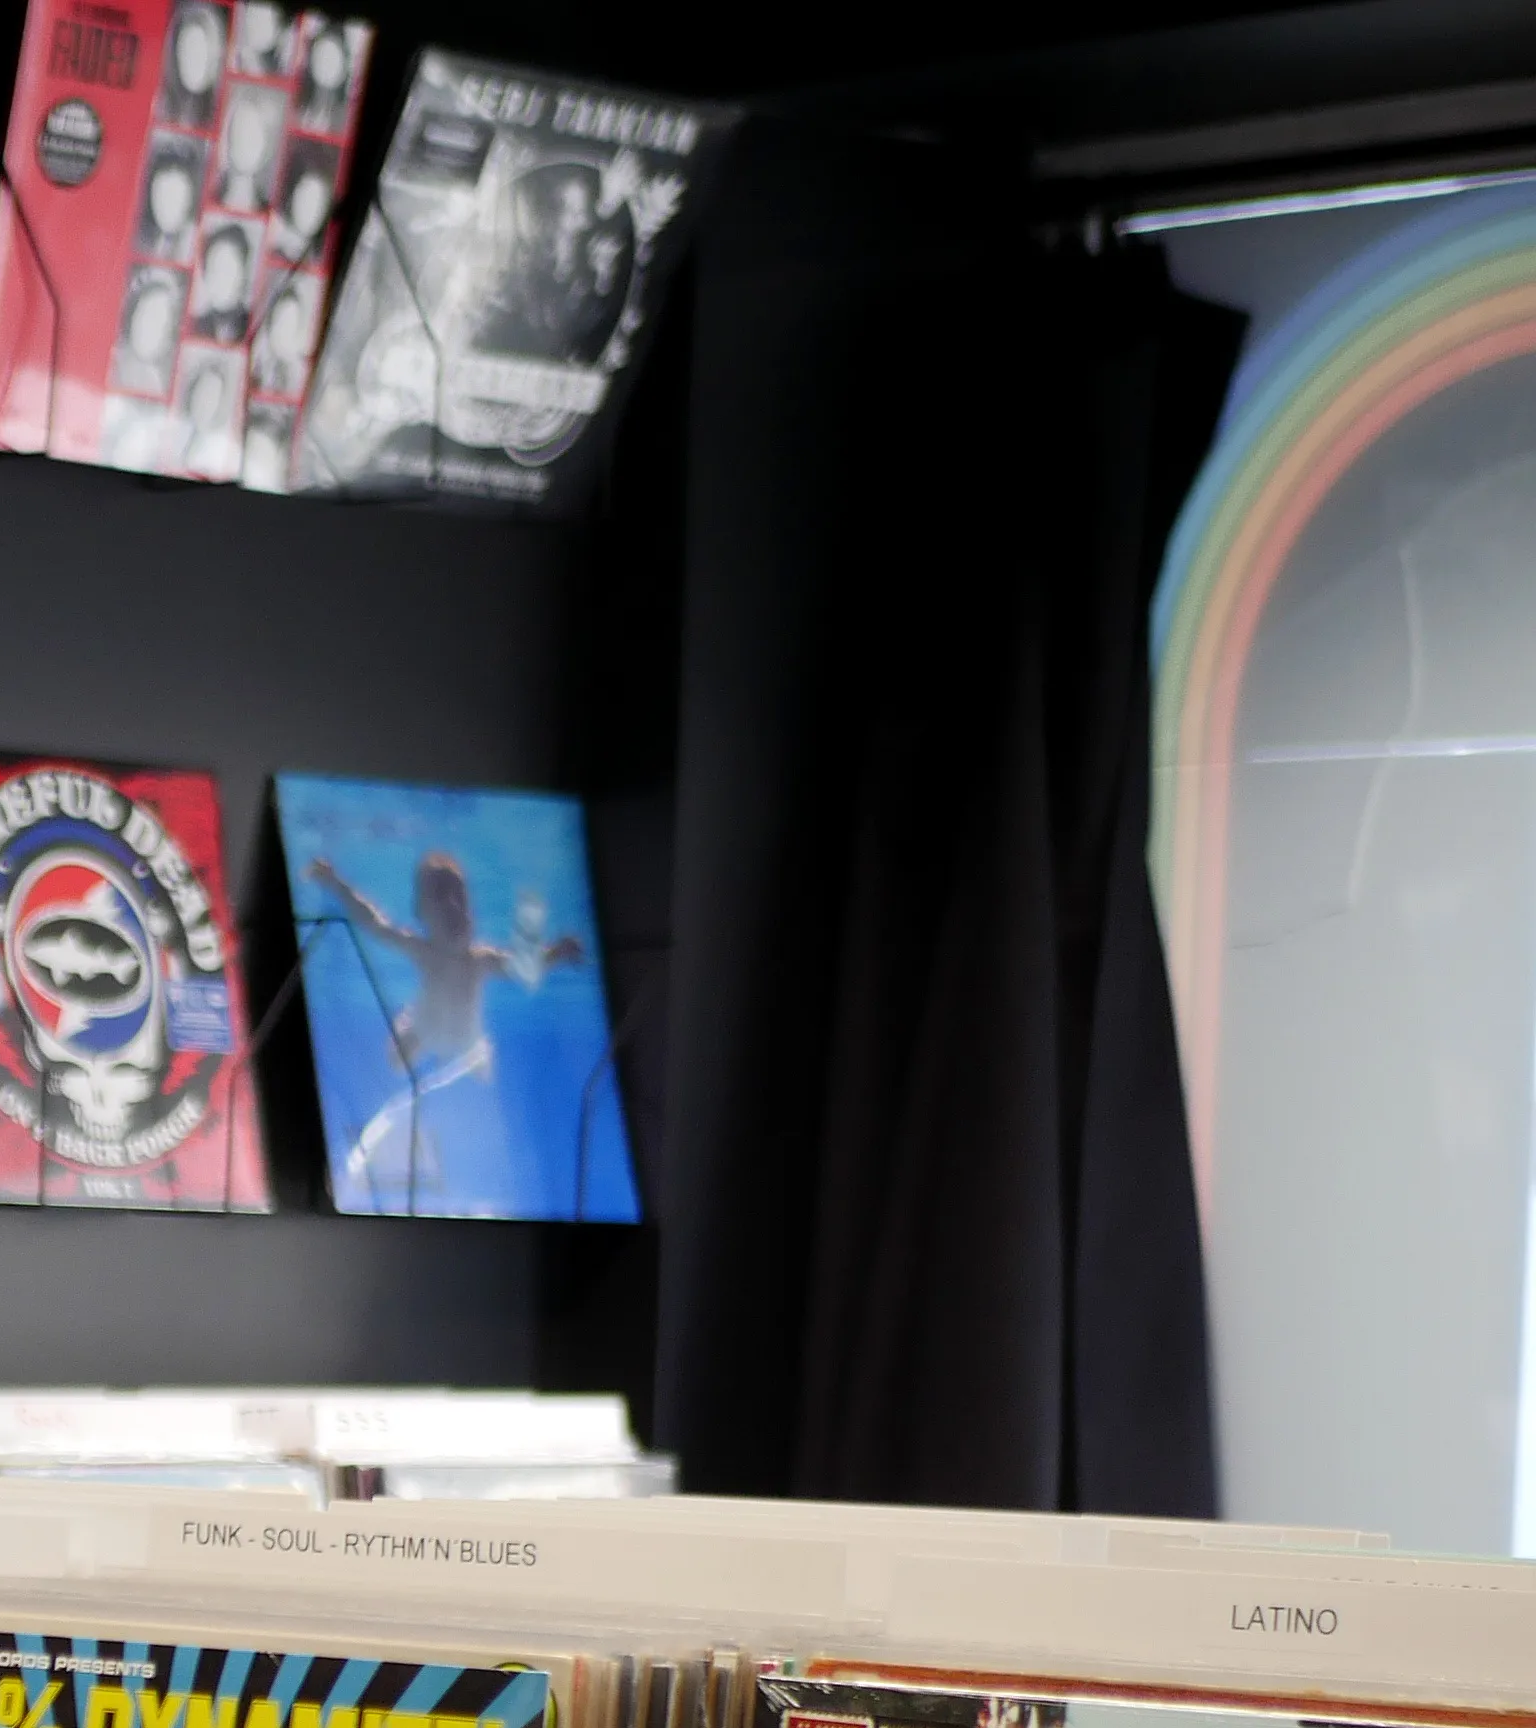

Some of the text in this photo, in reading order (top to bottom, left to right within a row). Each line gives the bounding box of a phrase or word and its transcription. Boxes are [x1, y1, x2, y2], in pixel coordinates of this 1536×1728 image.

[181, 1521, 243, 1547] FUNK
[262, 1527, 323, 1554] SOUL
[1230, 1604, 1339, 1636] LATINO
[54, 1656, 157, 1679] PRESENTS
